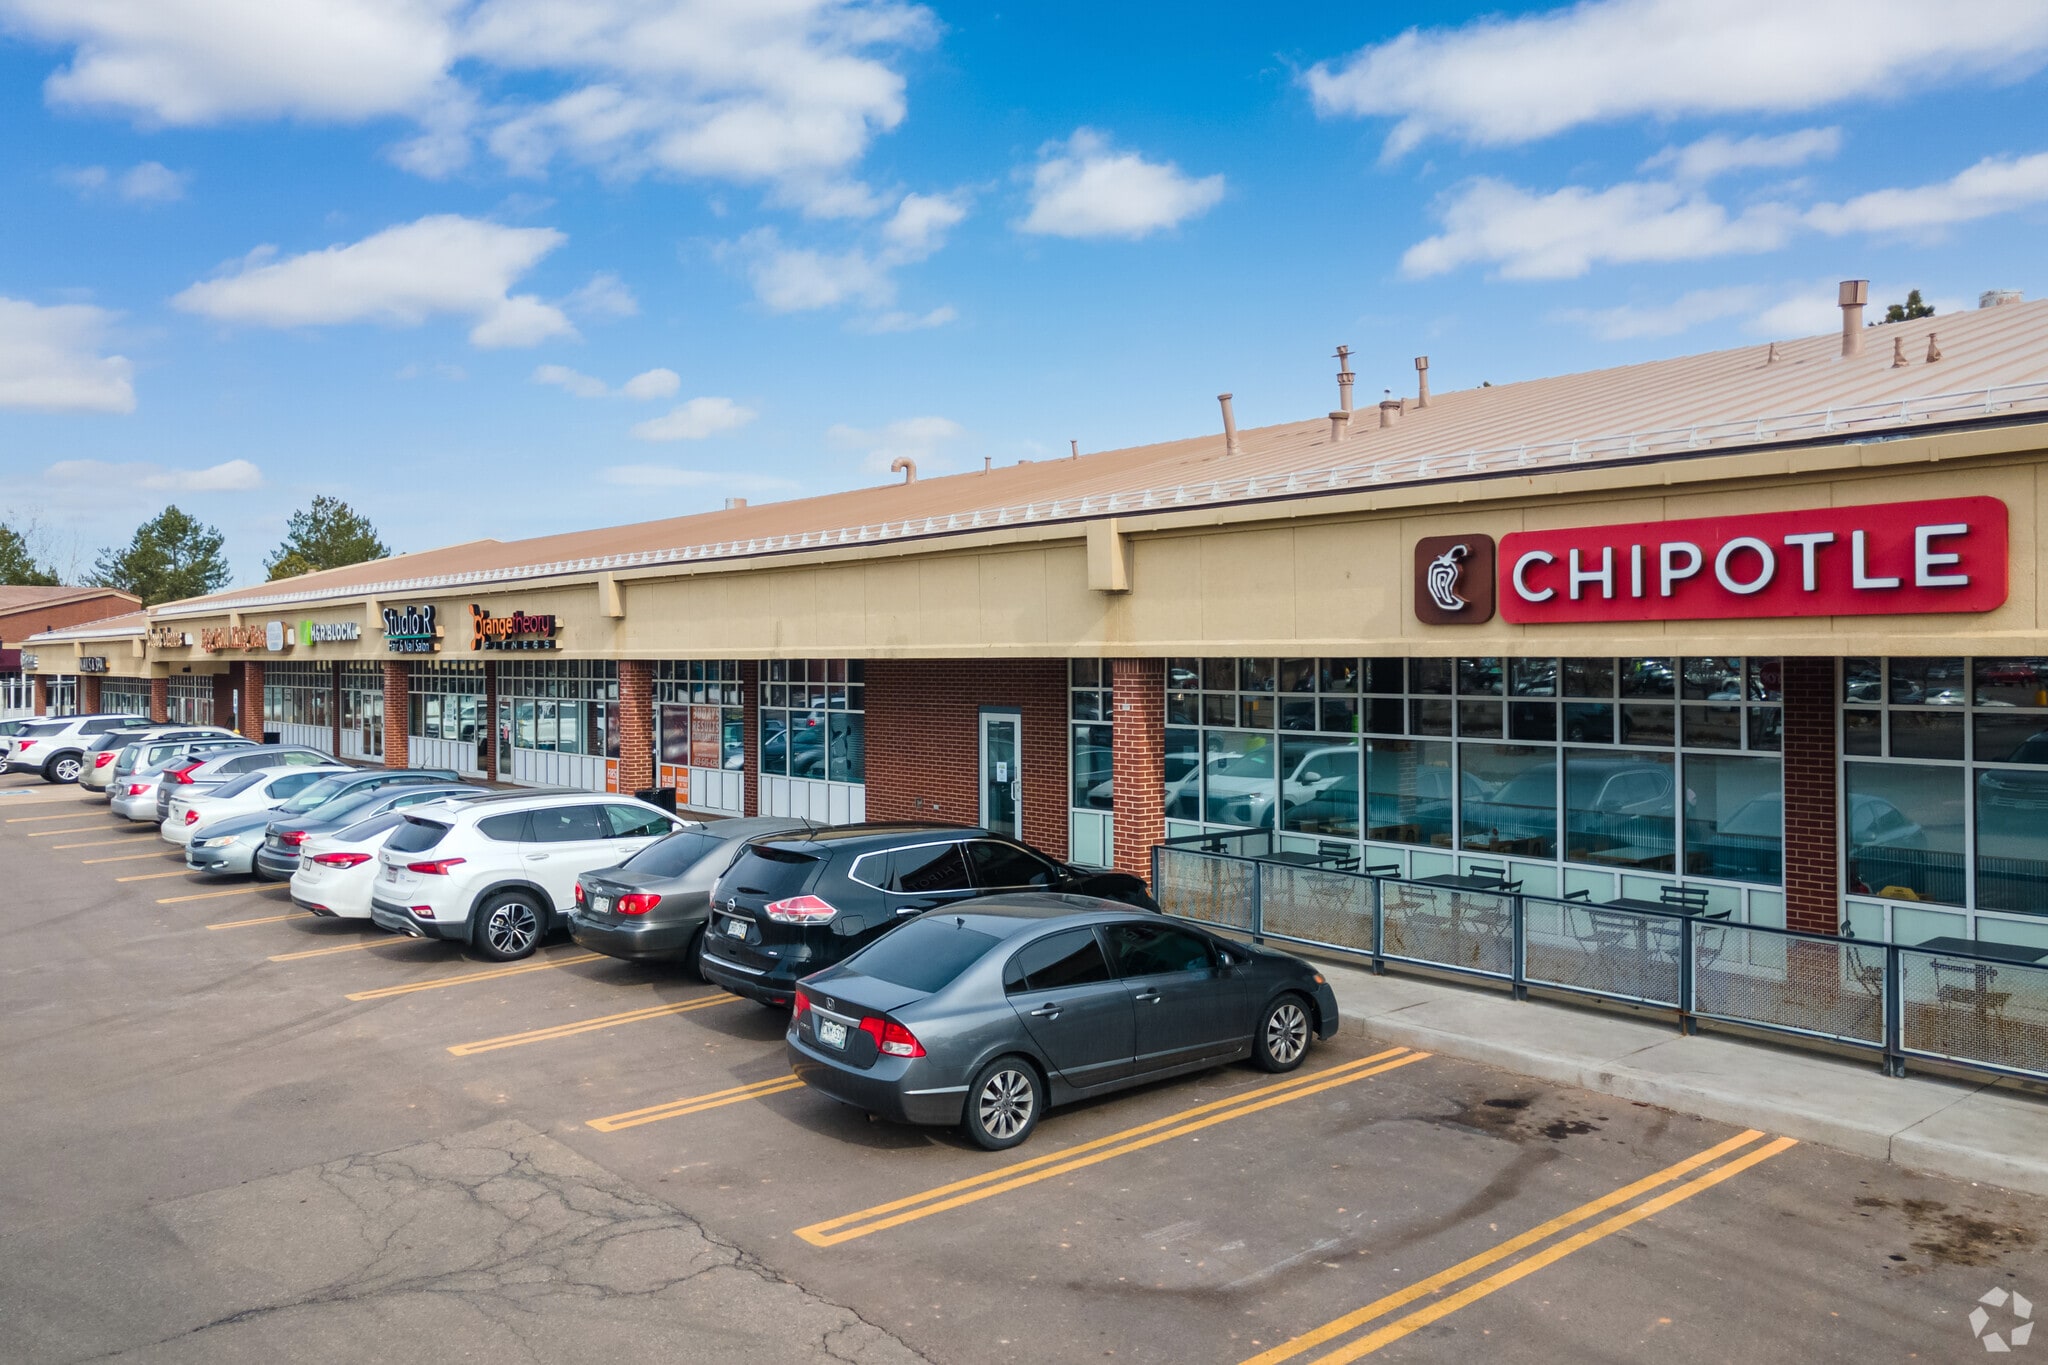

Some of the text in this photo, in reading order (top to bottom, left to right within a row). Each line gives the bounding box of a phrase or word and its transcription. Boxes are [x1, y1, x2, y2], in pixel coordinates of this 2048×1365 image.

[1512, 523, 1971, 603] CHIPOTLE
[383, 605, 431, 636] Studio R
[310, 622, 353, 642] H&R BLOCK
[389, 640, 399, 652] Hair
[404, 639, 414, 652] Nail
[415, 639, 430, 653] Salon
[484, 640, 551, 650] FITNESS
[692, 720, 720, 733] RESULTS
